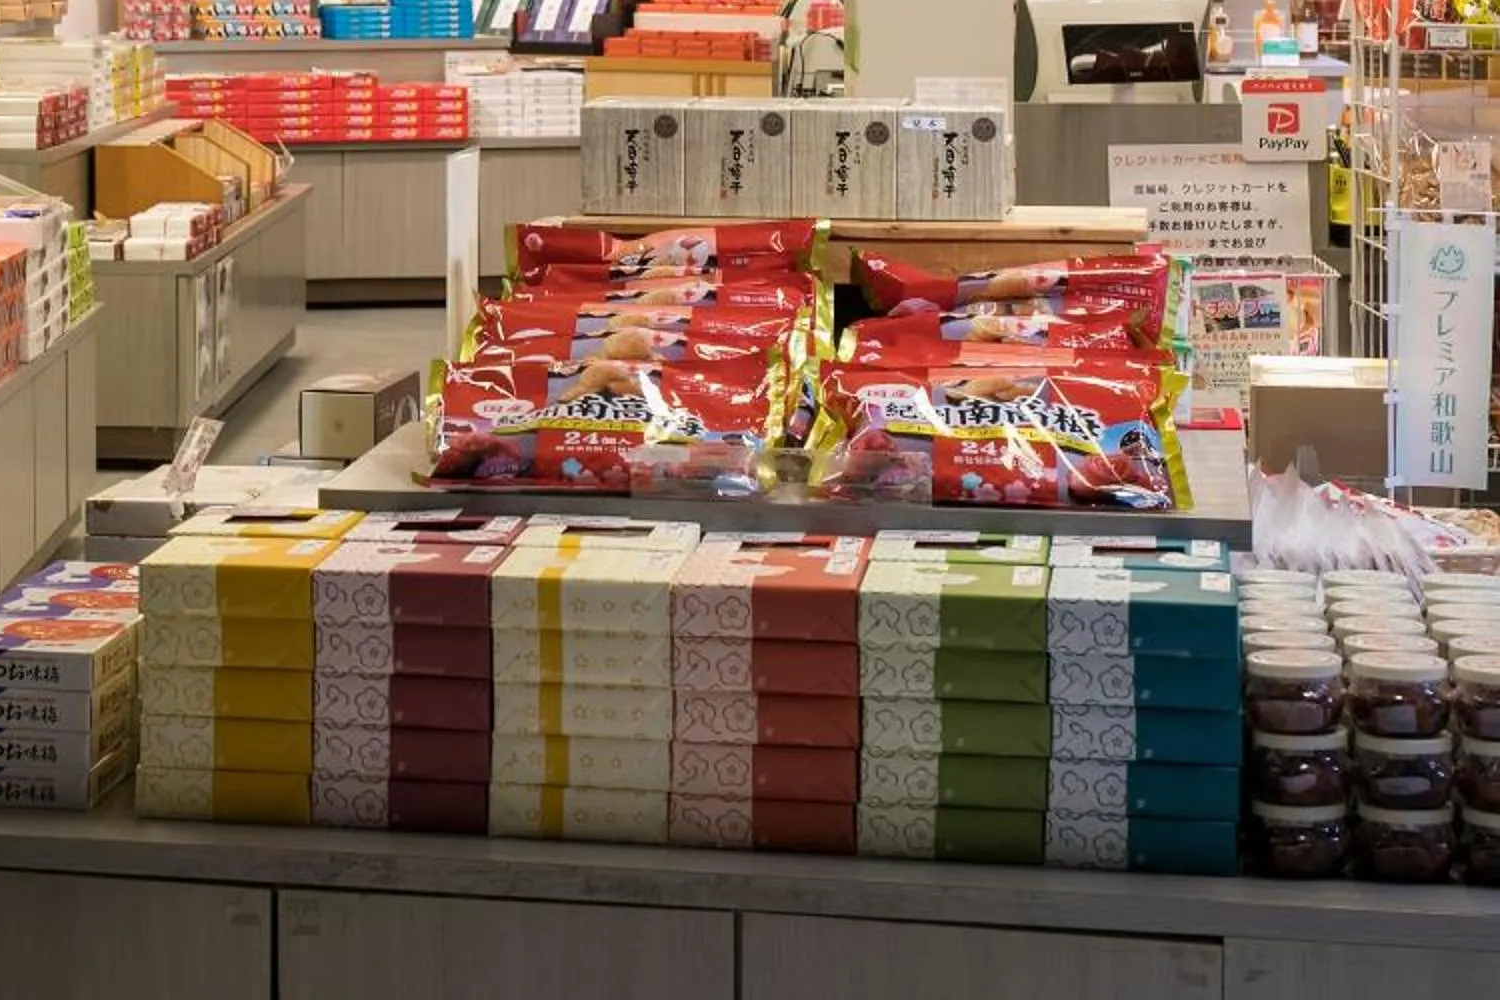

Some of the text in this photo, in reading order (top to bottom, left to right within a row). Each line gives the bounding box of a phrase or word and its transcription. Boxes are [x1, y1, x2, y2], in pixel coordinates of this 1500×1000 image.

[1258, 137, 1309, 151] PayPay
[1429, 289, 1459, 475] プレミア和歌山
